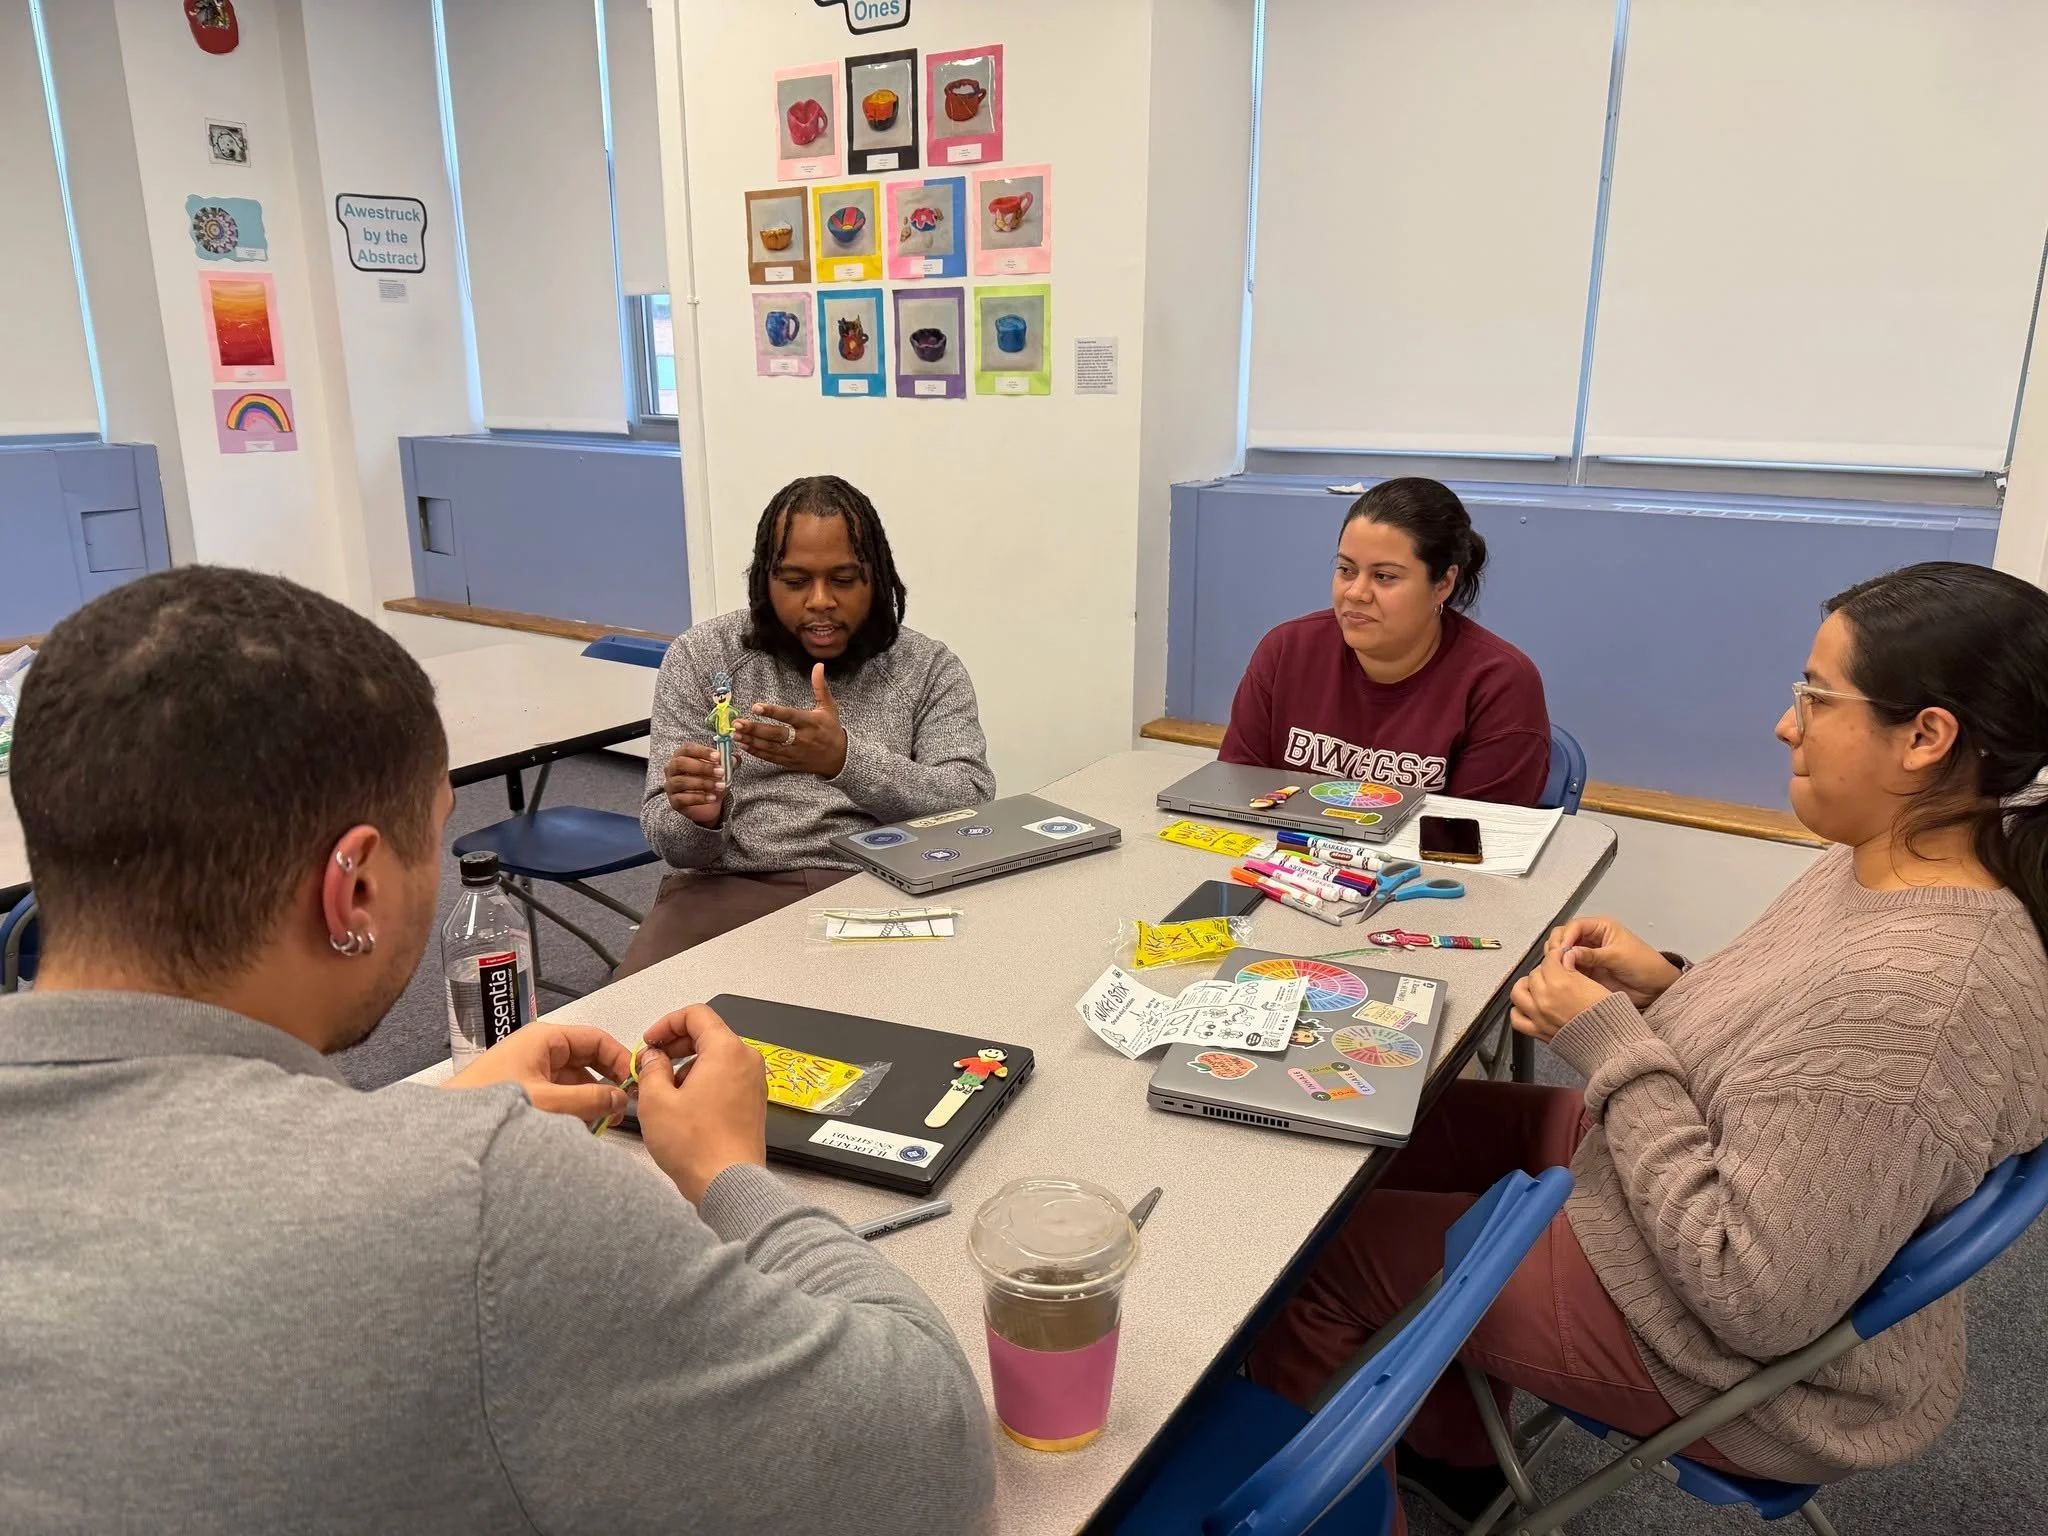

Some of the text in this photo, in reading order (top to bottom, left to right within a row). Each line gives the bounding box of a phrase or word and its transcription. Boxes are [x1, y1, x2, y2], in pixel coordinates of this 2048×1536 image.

[855, 0, 900, 20] Ones
[344, 203, 420, 222] Awestruck
[363, 227, 408, 245] by the
[357, 249, 419, 265] Abstract
[1293, 1071, 1316, 1090] INHALE
[1345, 1072, 1370, 1092] EXHALE
